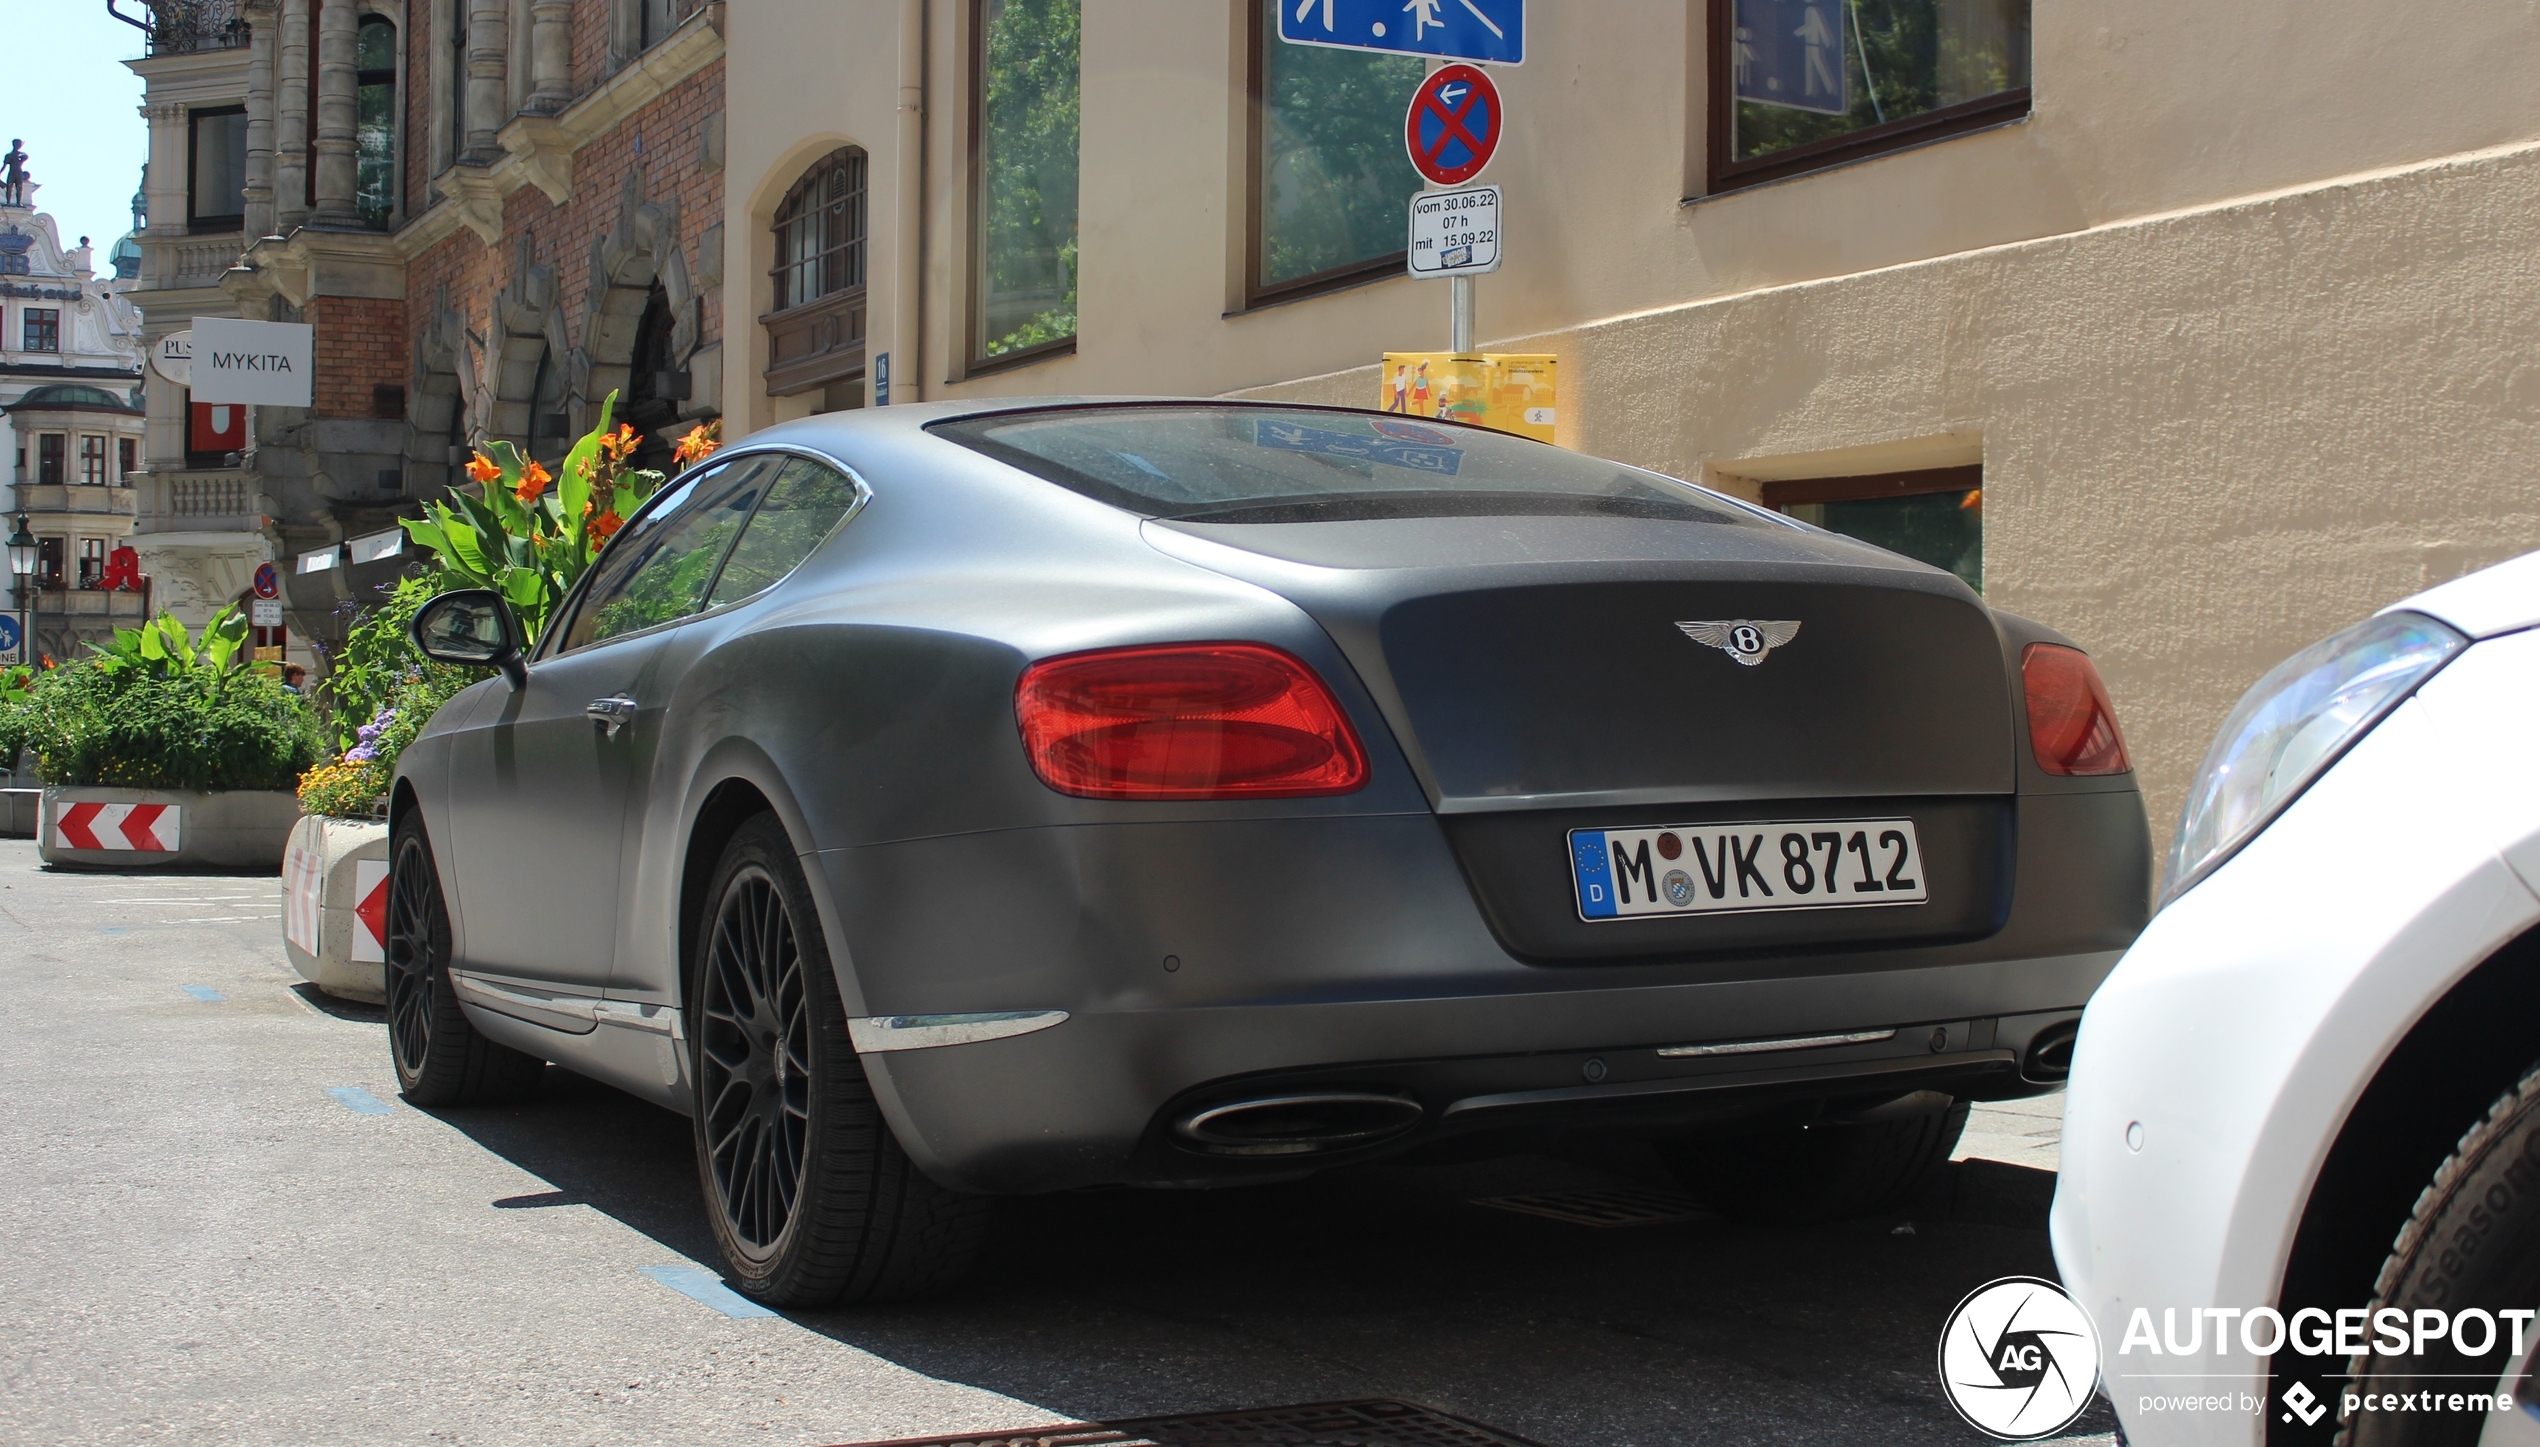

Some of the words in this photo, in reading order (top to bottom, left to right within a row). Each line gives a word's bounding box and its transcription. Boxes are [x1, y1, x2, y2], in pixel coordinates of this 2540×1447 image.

[1416, 202, 1440, 214] vom
[1444, 193, 1494, 211] 30.06.22
[1443, 216, 1457, 229] 07
[1461, 215, 1468, 227] h
[1415, 237, 1433, 250] mit
[1444, 230, 1494, 247] 15.09.22
[213, 352, 292, 372] MYKITA
[877, 358, 886, 380] 16
[0, 653, 17, 662] NE
[1612, 839, 1657, 904] M
[1692, 834, 1774, 899] VK
[1780, 830, 1916, 895] 8712
[1589, 884, 1603, 902] D
